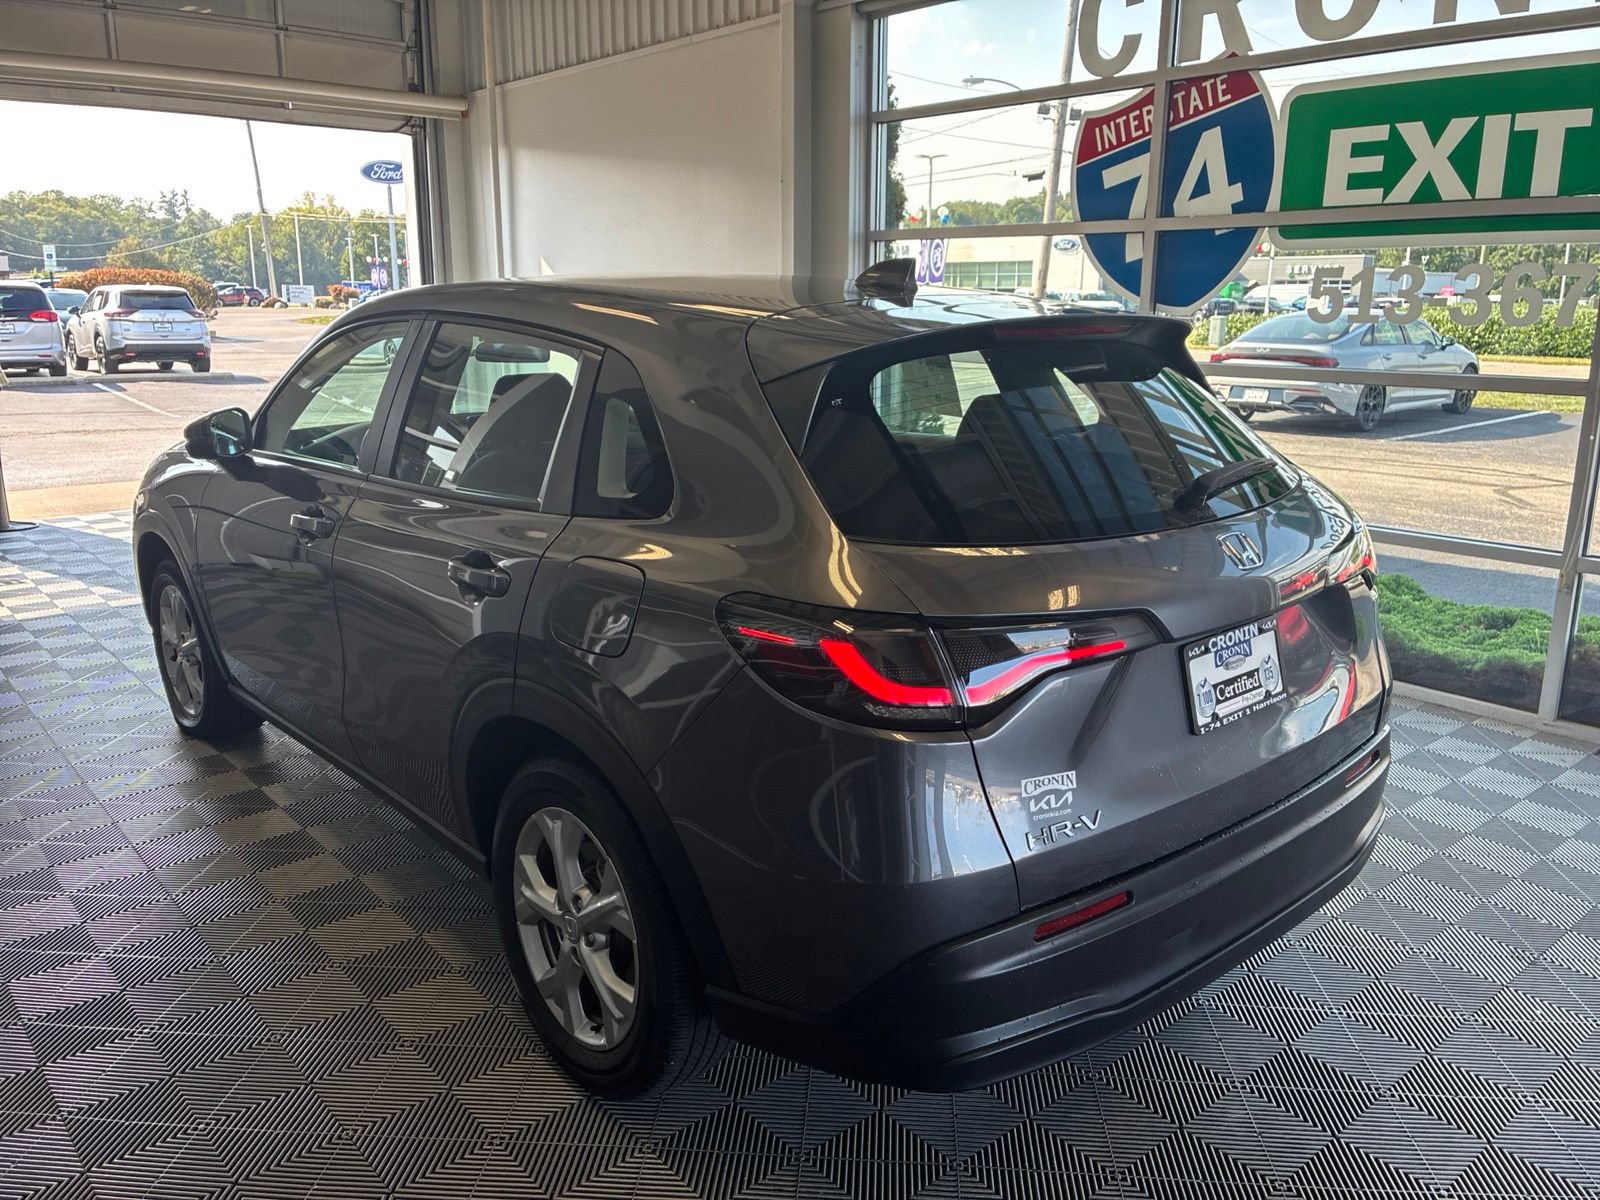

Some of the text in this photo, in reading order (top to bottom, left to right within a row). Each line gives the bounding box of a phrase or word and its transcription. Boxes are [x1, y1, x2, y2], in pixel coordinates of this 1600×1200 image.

[1095, 74, 1232, 152] INTERTATE
[370, 163, 402, 179] Ford
[1322, 108, 1593, 207] EXIT
[1102, 126, 1244, 263] 74
[1286, 264, 1342, 275] SERV
[1307, 262, 1598, 328] 513-367
[1208, 623, 1259, 652] CRONIN
[1215, 641, 1251, 666] CRONIN
[1216, 672, 1260, 701] Certified
[1200, 720, 1221, 735] I-74
[1222, 711, 1245, 725] EXIT
[1252, 692, 1287, 713] Harrison
[1023, 773, 1074, 796] CRONIN
[1029, 790, 1073, 813] KIA
[1032, 808, 1072, 821] croninkia.com
[1025, 809, 1102, 851] HR-V
